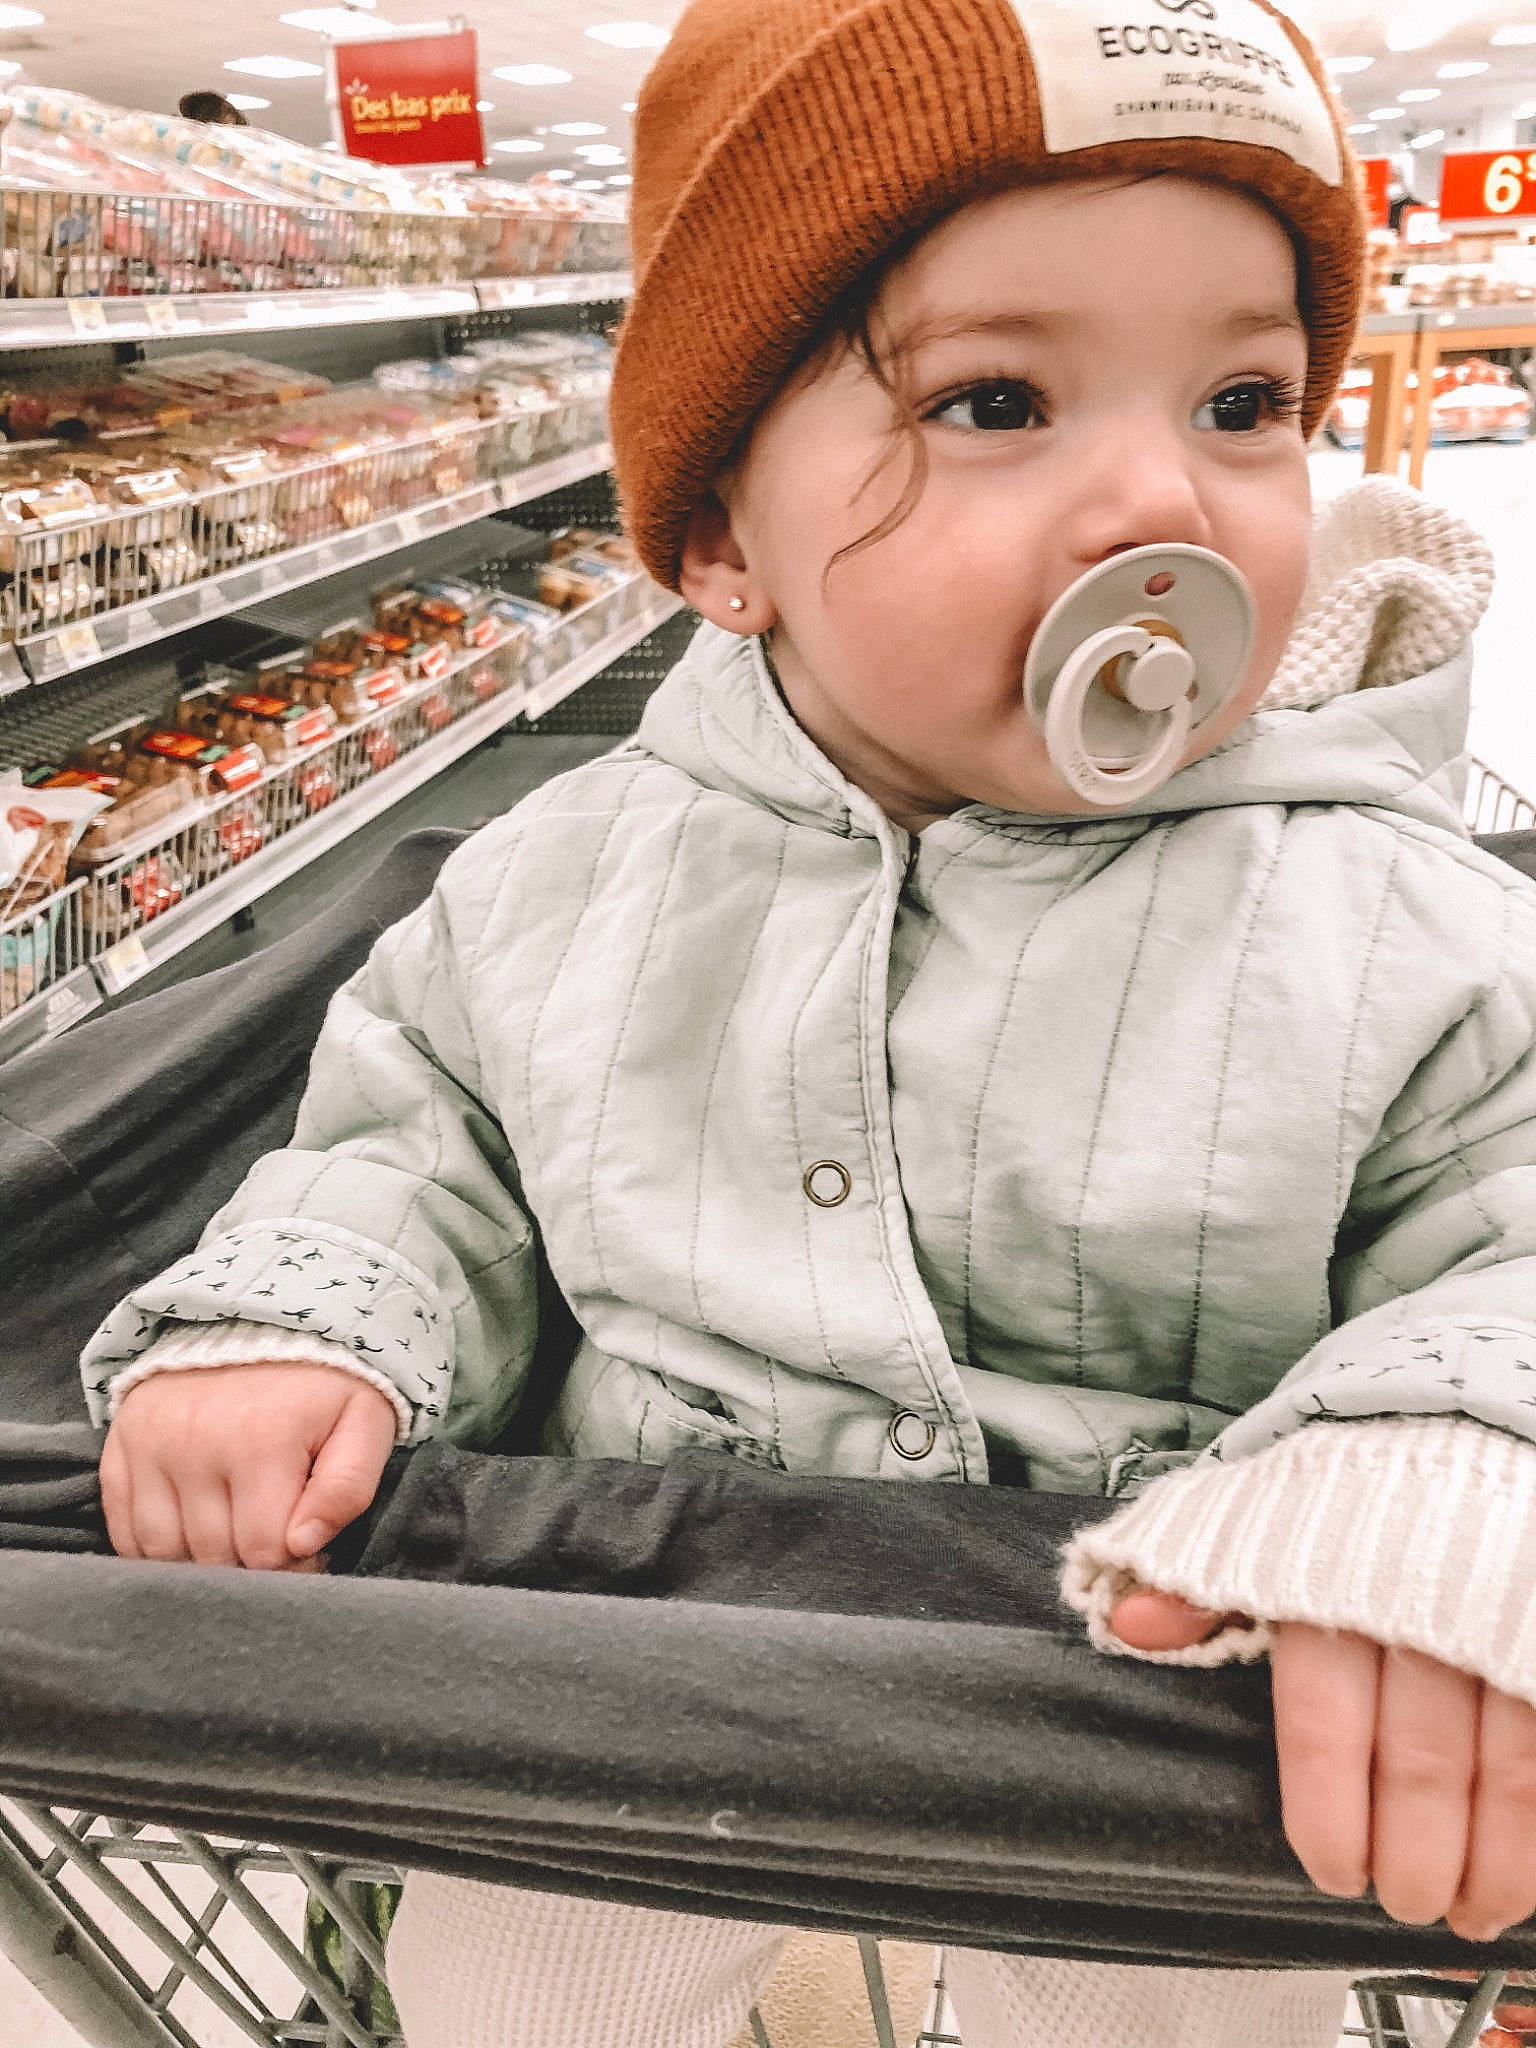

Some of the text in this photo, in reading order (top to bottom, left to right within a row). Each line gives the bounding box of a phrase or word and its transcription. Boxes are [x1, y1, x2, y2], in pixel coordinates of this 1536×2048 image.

[1097, 24, 1296, 89] ECOGRIFFE
[351, 87, 472, 122] Des bas prix
